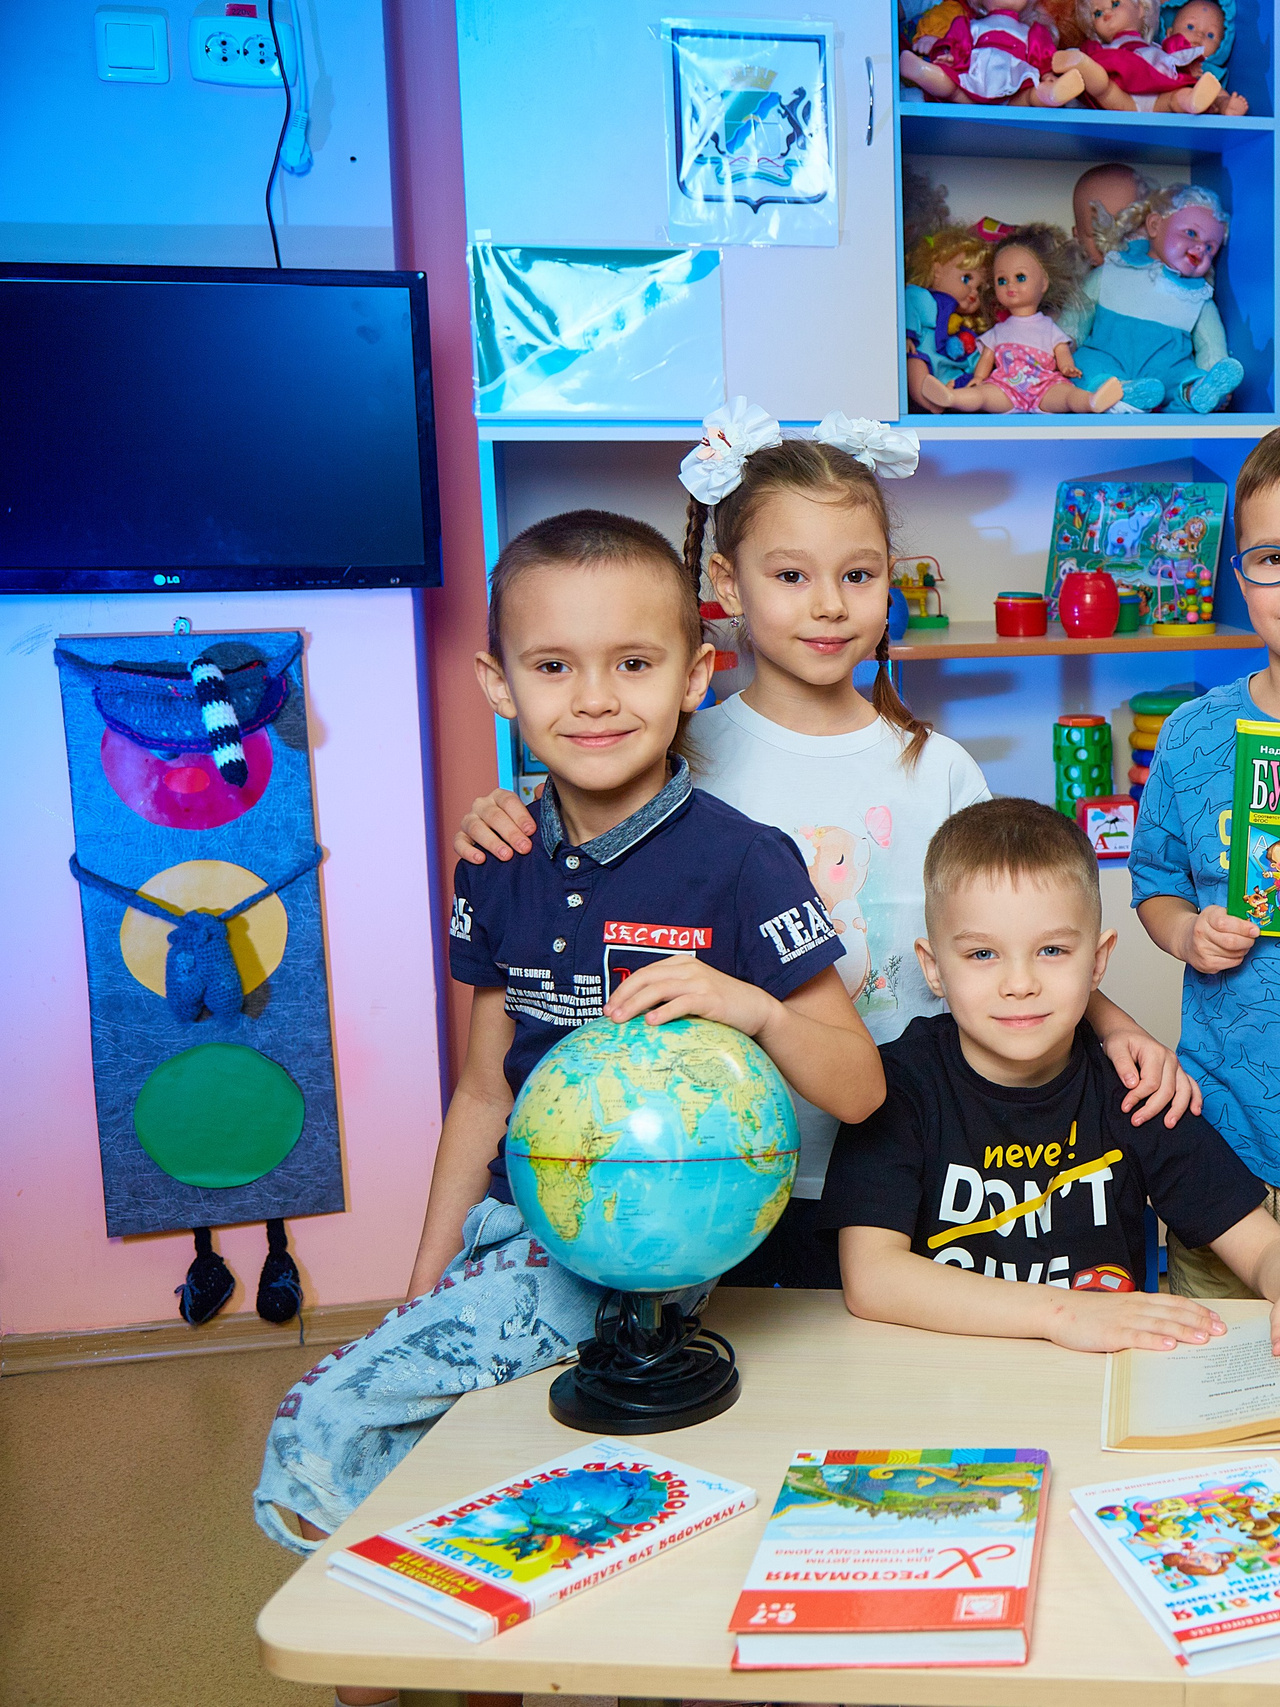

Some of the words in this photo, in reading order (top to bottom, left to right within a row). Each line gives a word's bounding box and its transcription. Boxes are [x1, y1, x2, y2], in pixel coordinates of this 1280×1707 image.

[167, 576, 180, 584] LG
[1095, 833, 1110, 850] А
[604, 923, 706, 949] SECTION
[509, 966, 524, 978] KITE
[523, 968, 552, 980] SURFER
[581, 985, 603, 997] TIME
[576, 1007, 604, 1018] AREAS
[938, 1163, 1114, 1239] DON'T
[582, 1461, 653, 1475] ДУБ
[658, 1504, 735, 1550] ЛУКОМОРЬЯ
[420, 1537, 513, 1580] СКАЗКИ
[628, 1544, 654, 1564] ДУБ
[775, 1548, 813, 1556] дома
[828, 1548, 860, 1556] саду
[864, 1547, 924, 1556] детском
[806, 1556, 850, 1565] детям
[853, 1557, 903, 1565] чтения
[748, 1610, 797, 1624] 6-7
